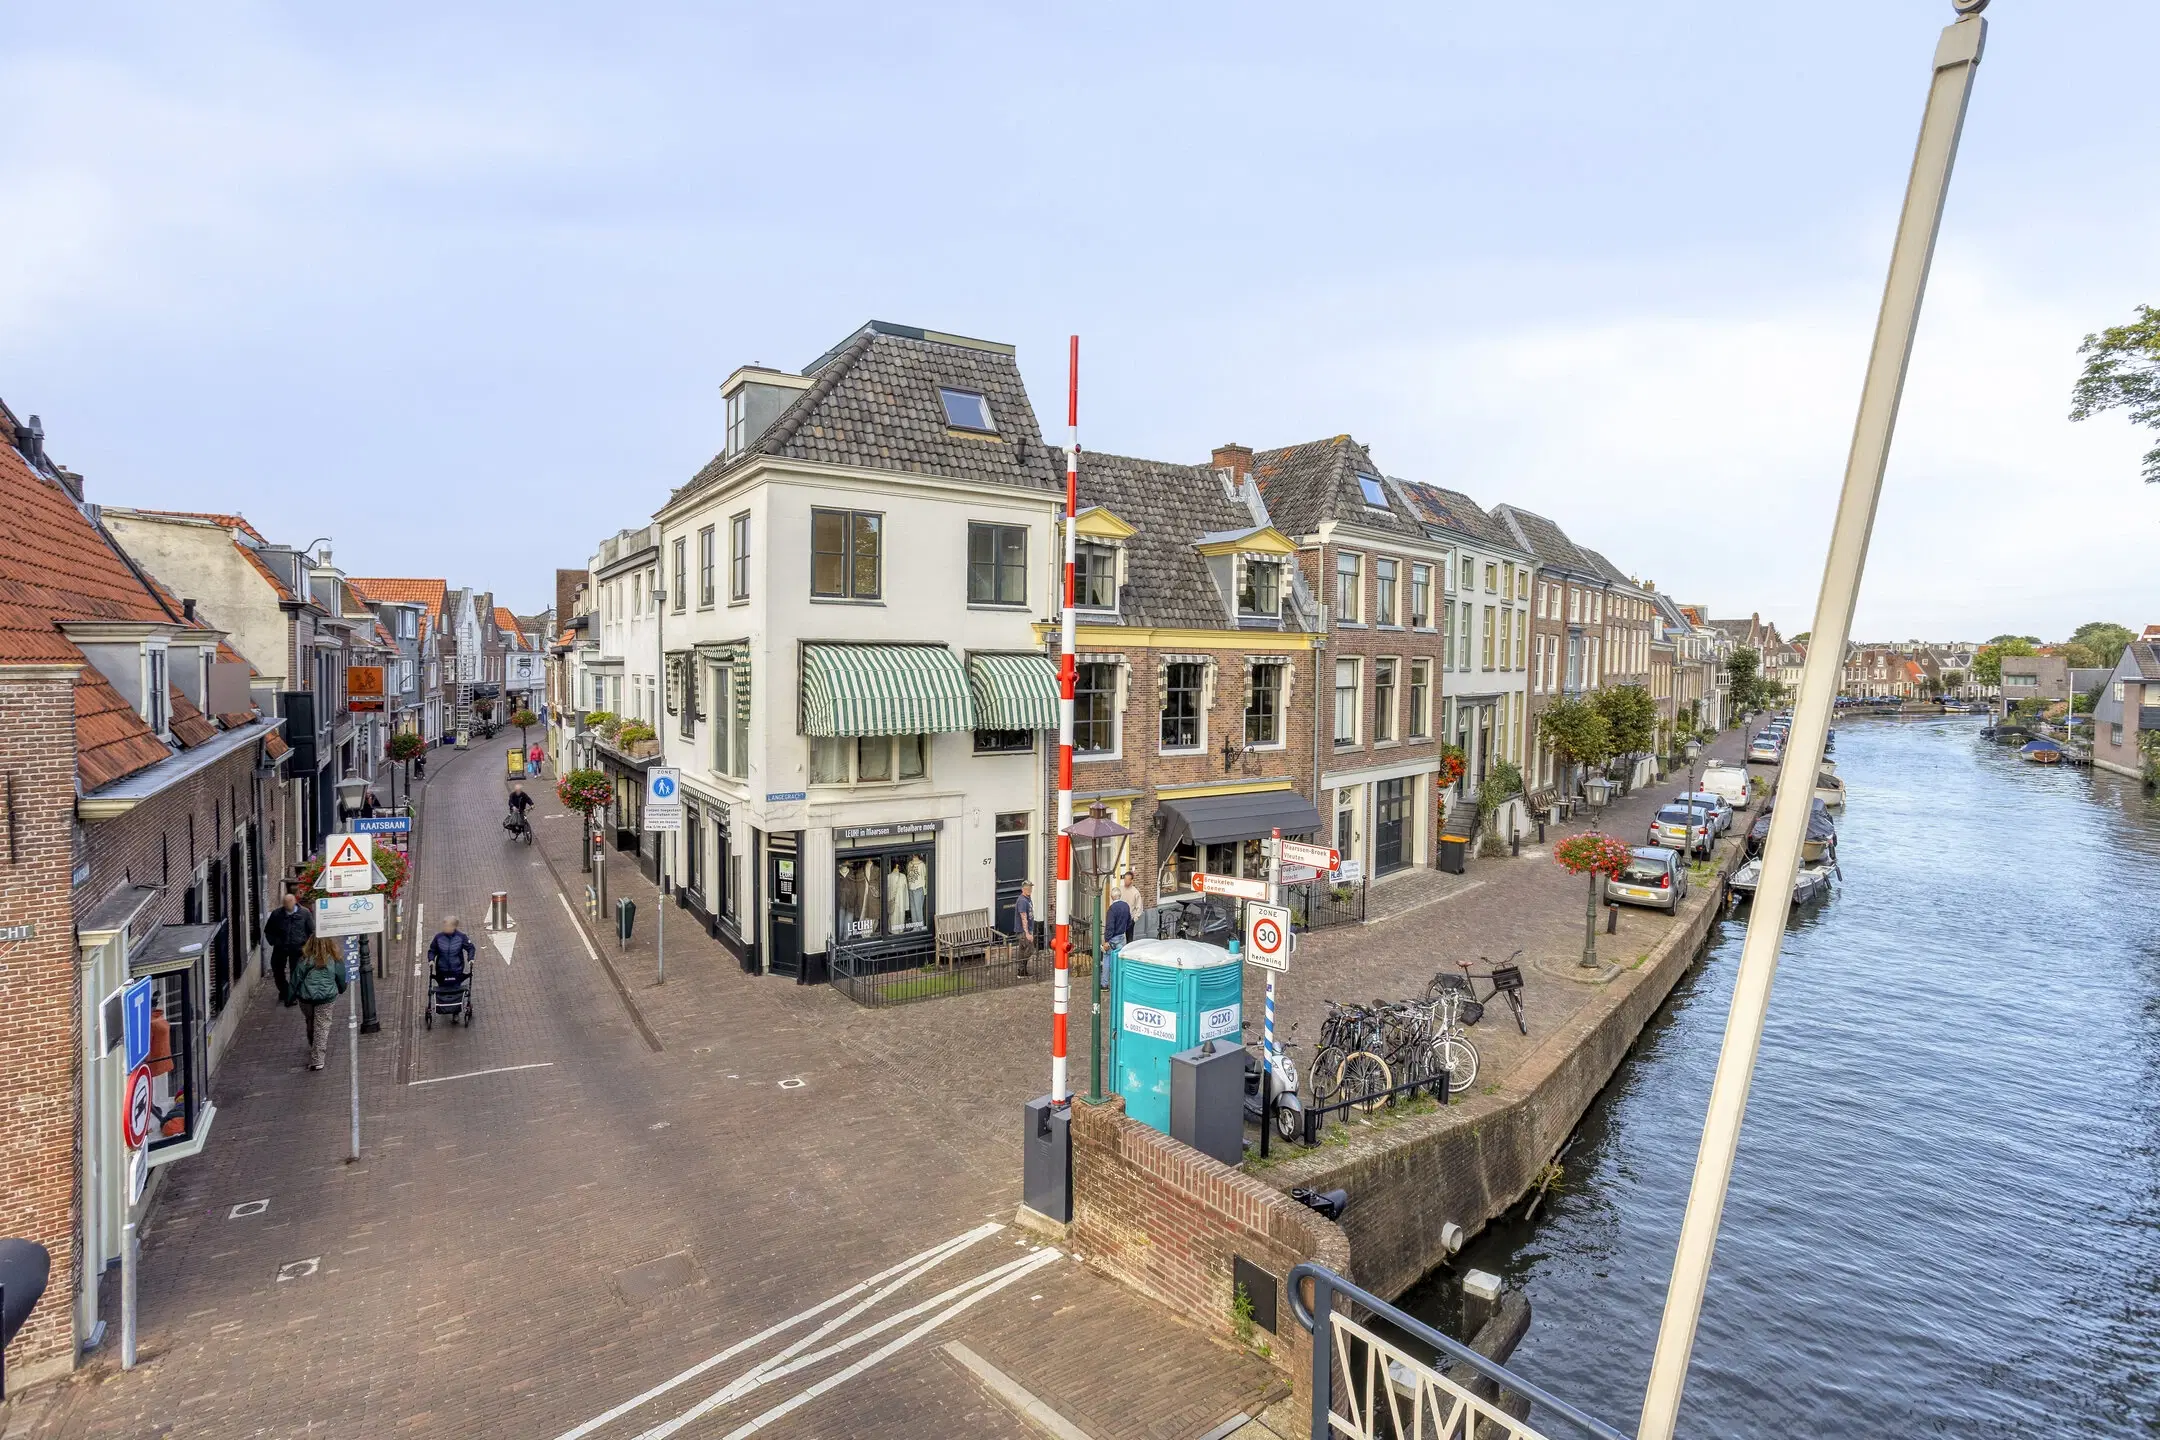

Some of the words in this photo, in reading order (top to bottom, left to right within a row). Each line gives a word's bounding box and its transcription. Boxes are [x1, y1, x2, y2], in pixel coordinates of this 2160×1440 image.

[360, 821, 405, 831] KAATSBAAN
[897, 824, 922, 834] Betaalbare
[923, 823, 936, 831] mode
[860, 828, 865, 837] in
[866, 827, 890, 836] Maarssen
[1284, 844, 1327, 857] Maarssen-Broek
[1284, 852, 1304, 861] Vleuten
[982, 858, 992, 866] 57
[1204, 877, 1235, 887] Breukelen
[1203, 885, 1226, 893] Loenen
[1258, 908, 1278, 918] ZONE
[847, 919, 873, 932] LEUK!
[1258, 928, 1276, 943] 30
[1251, 953, 1282, 967] herhaling
